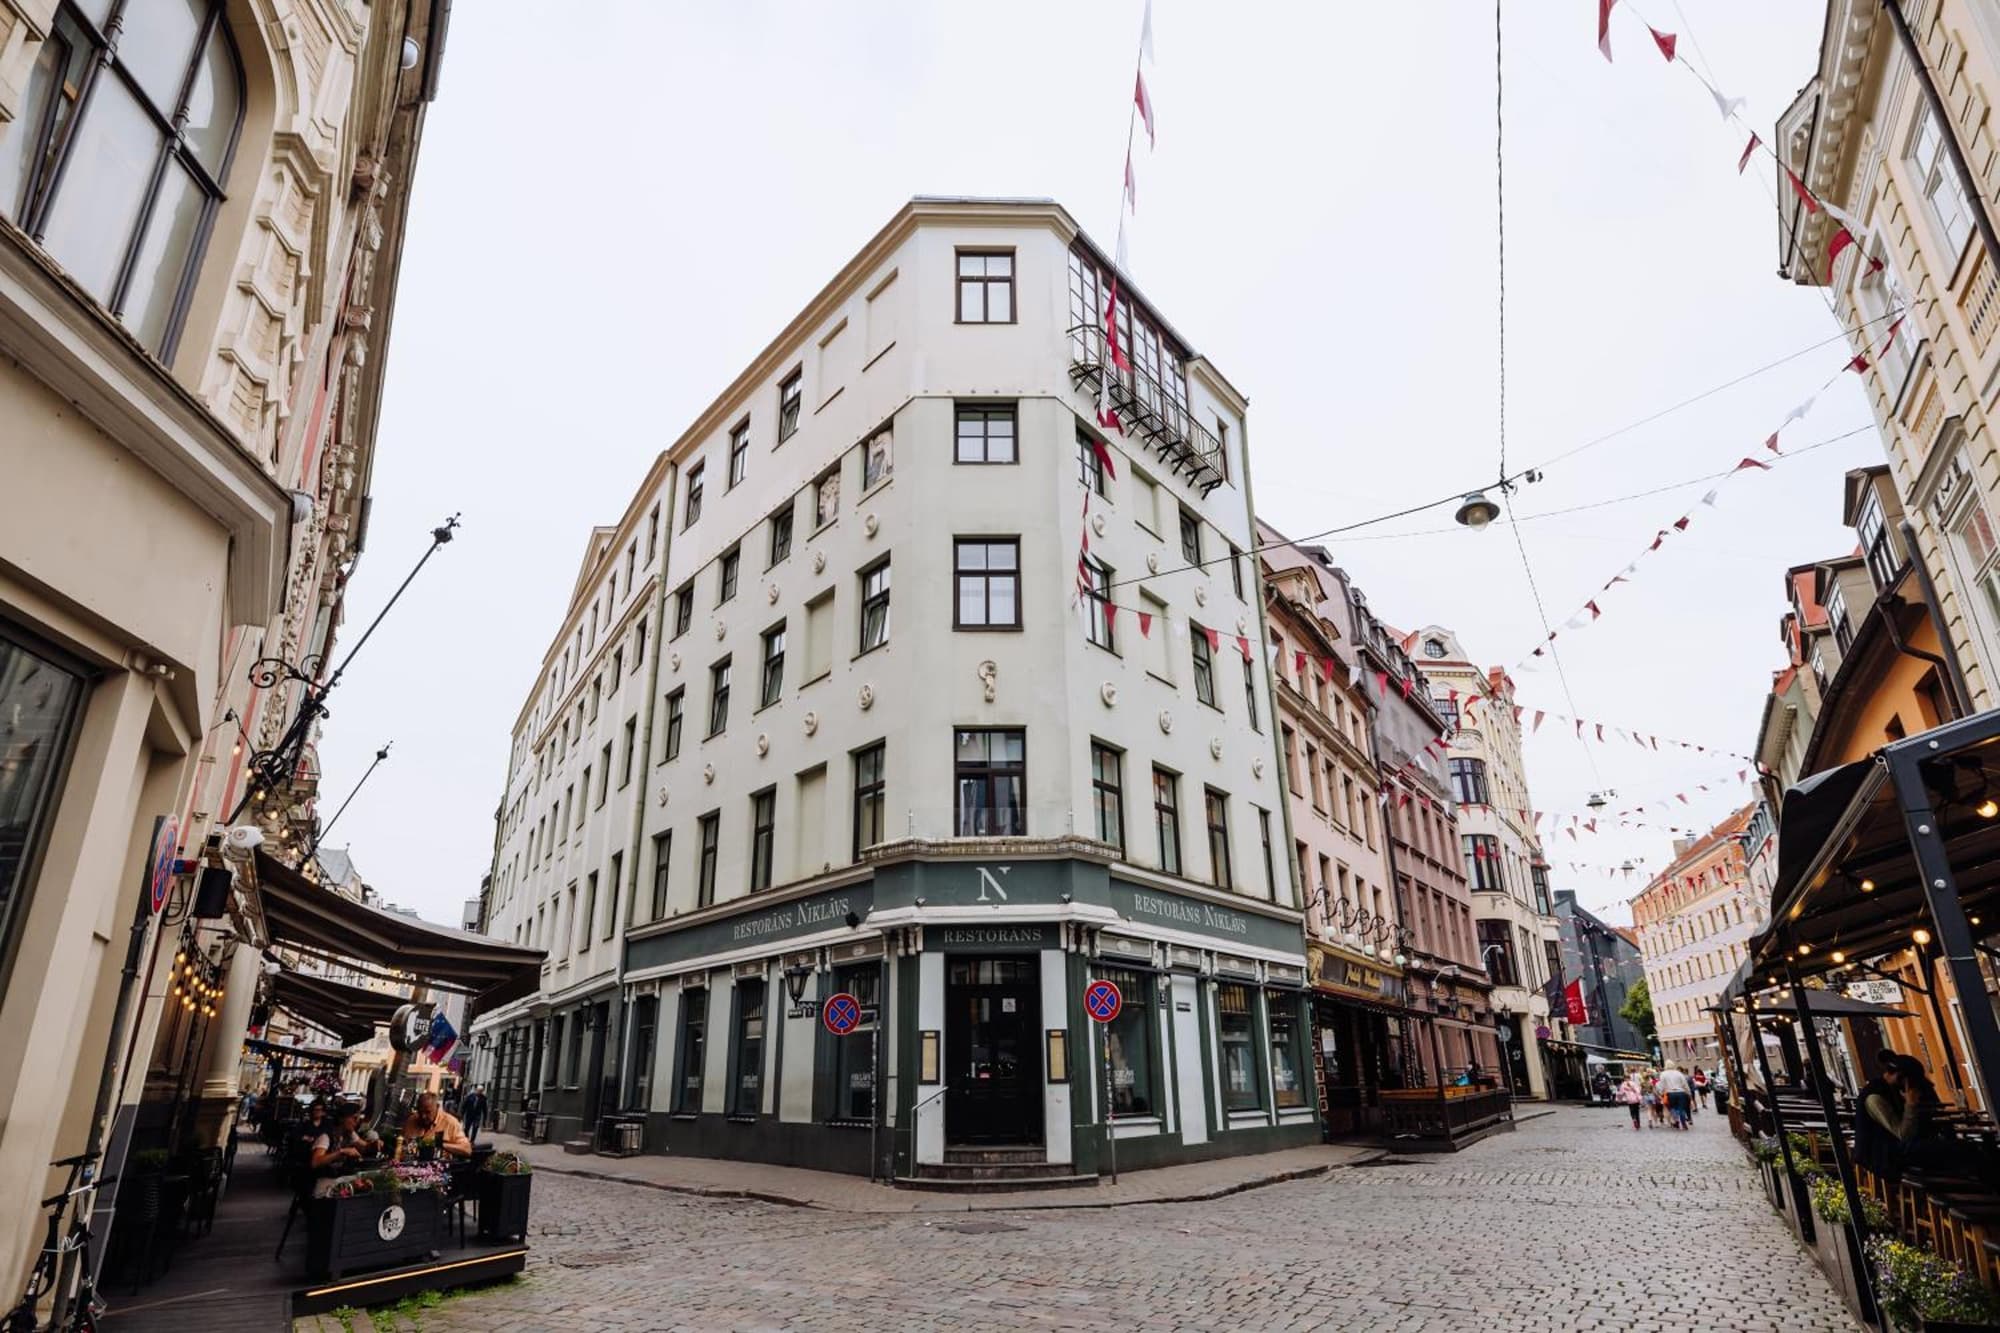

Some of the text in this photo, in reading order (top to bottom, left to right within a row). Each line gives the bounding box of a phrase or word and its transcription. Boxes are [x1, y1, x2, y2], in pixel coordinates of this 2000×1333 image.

[976, 866, 1011, 901] N
[734, 898, 849, 940] RESTORĀNS NIKLĀVS
[1134, 893, 1201, 923] RESTORĀNS
